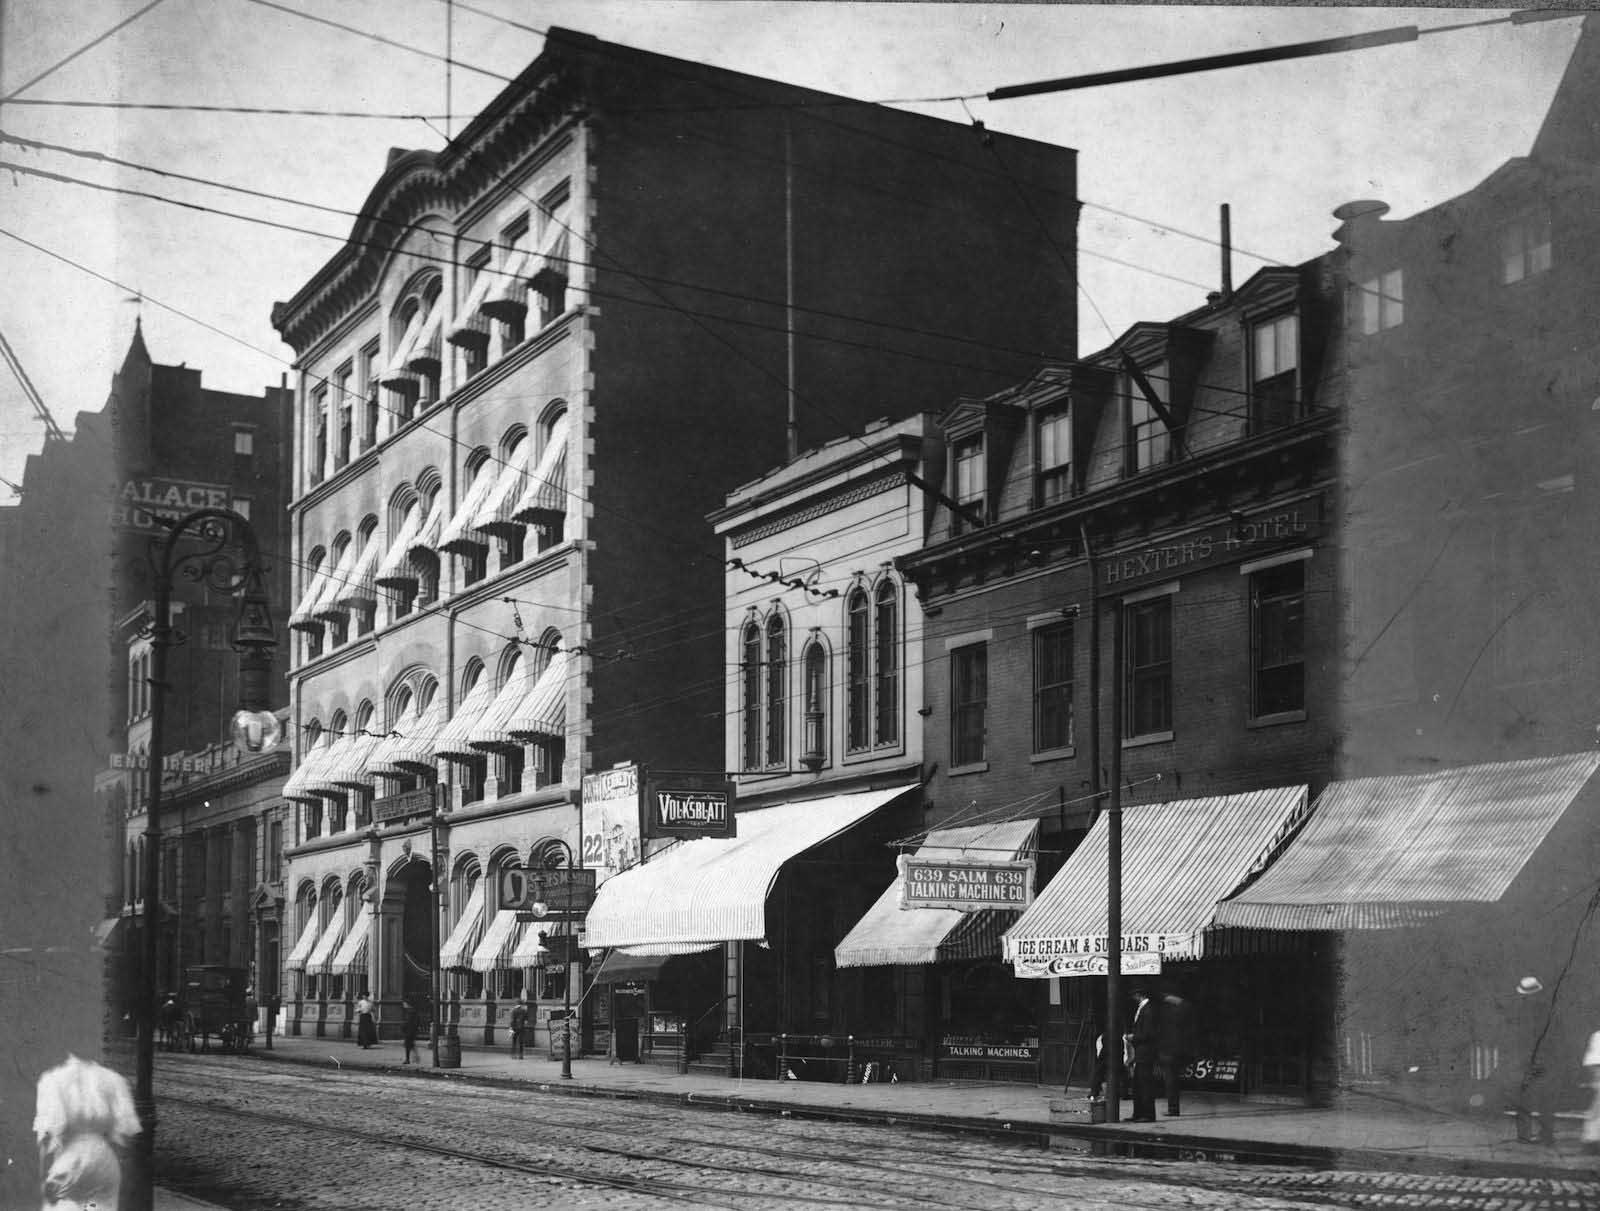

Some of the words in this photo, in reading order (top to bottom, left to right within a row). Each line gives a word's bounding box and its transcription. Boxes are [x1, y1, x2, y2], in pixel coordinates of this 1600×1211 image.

[120, 480, 228, 511] ALACE
[657, 793, 727, 825] VOLKSBLATT
[914, 869, 943, 882] 639
[948, 870, 987, 883] SALM
[995, 871, 1022, 884] 639
[910, 882, 956, 898] TALKING
[959, 883, 1007, 899] MACHINE
[1009, 885, 1025, 901] CO.
[1018, 940, 1036, 955] ICE
[1038, 939, 1078, 954] CREAM
[1083, 938, 1090, 953] &
[1095, 936, 1149, 953] SUDAES
[949, 1046, 984, 1057] TALKING
[987, 1047, 1032, 1058] MACHINES.
